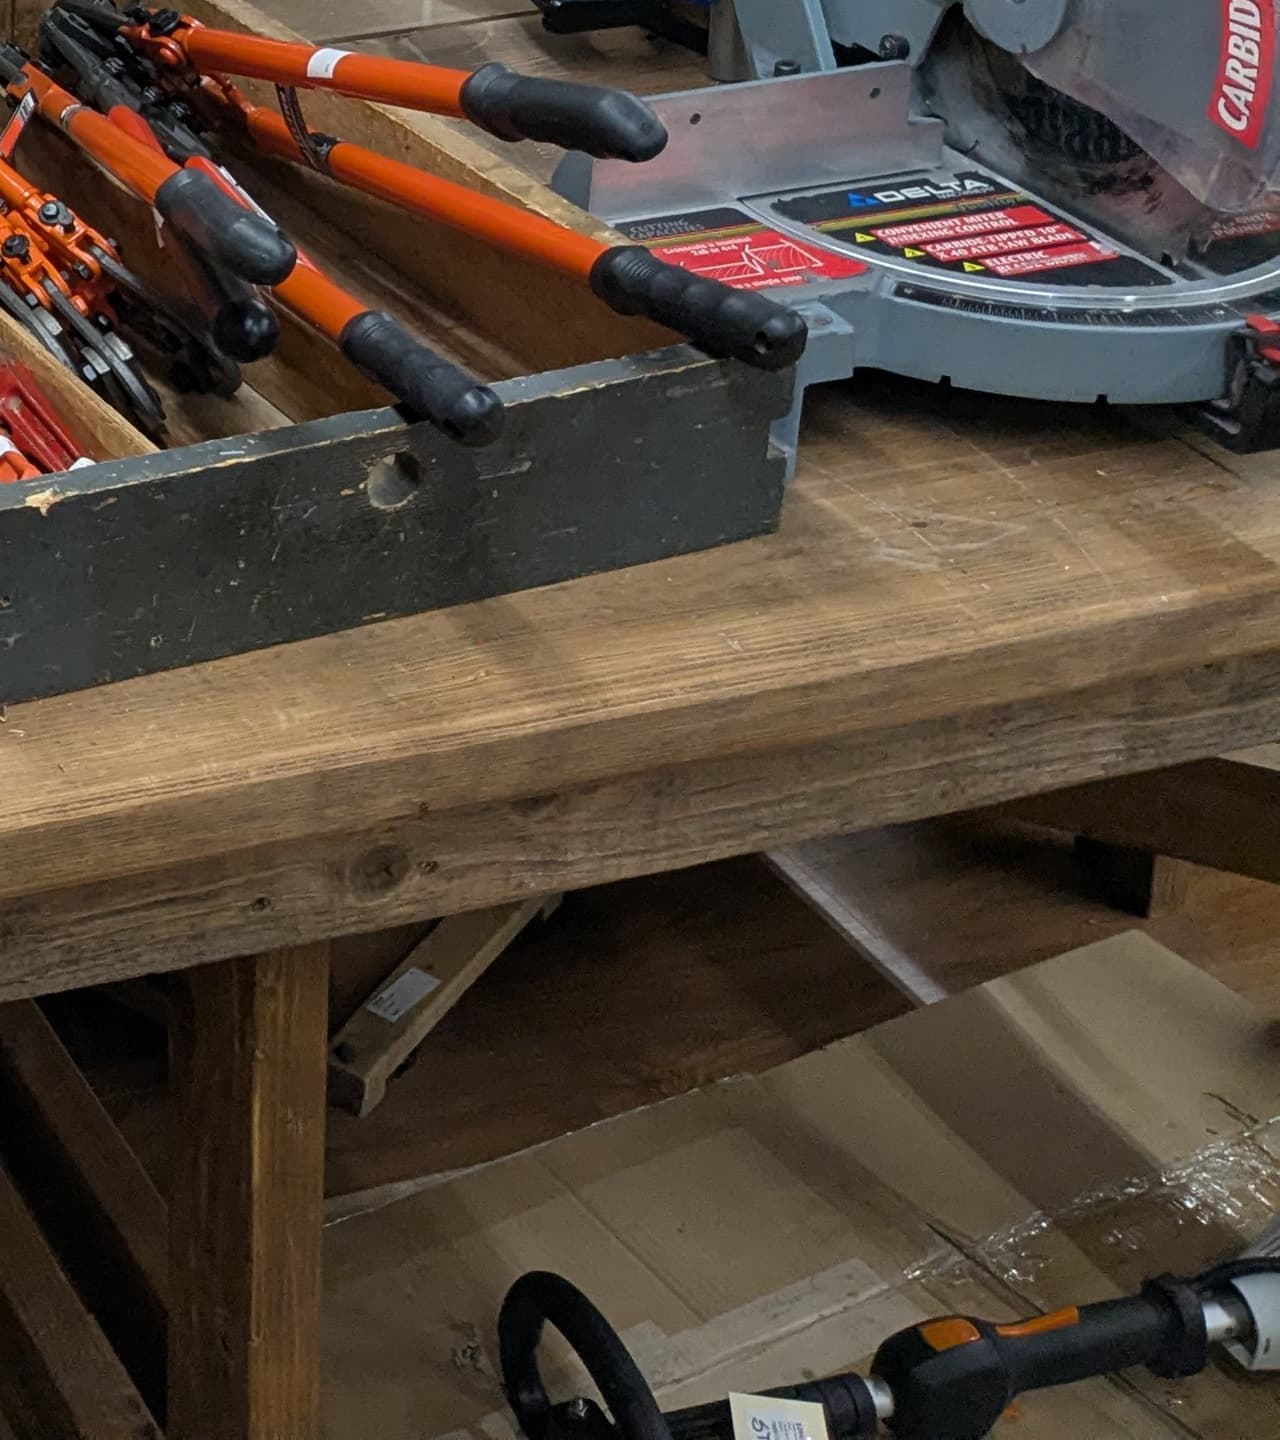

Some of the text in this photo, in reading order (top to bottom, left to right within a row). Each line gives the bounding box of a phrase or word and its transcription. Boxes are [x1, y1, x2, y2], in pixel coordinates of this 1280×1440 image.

[873, 177, 991, 203] DELTA
[630, 218, 689, 234] CUTTING
[630, 223, 705, 241] CAPACITIES
[877, 211, 1008, 238] CONVENIENT MITER
[888, 219, 1018, 246] INDEXING CONTROL
[926, 224, 1060, 253] CARBIDE-TIPPED 10"
[998, 239, 1027, 251] SAW
[1028, 232, 1074, 246] BLADE
[984, 249, 1047, 267] ELECTRIC
